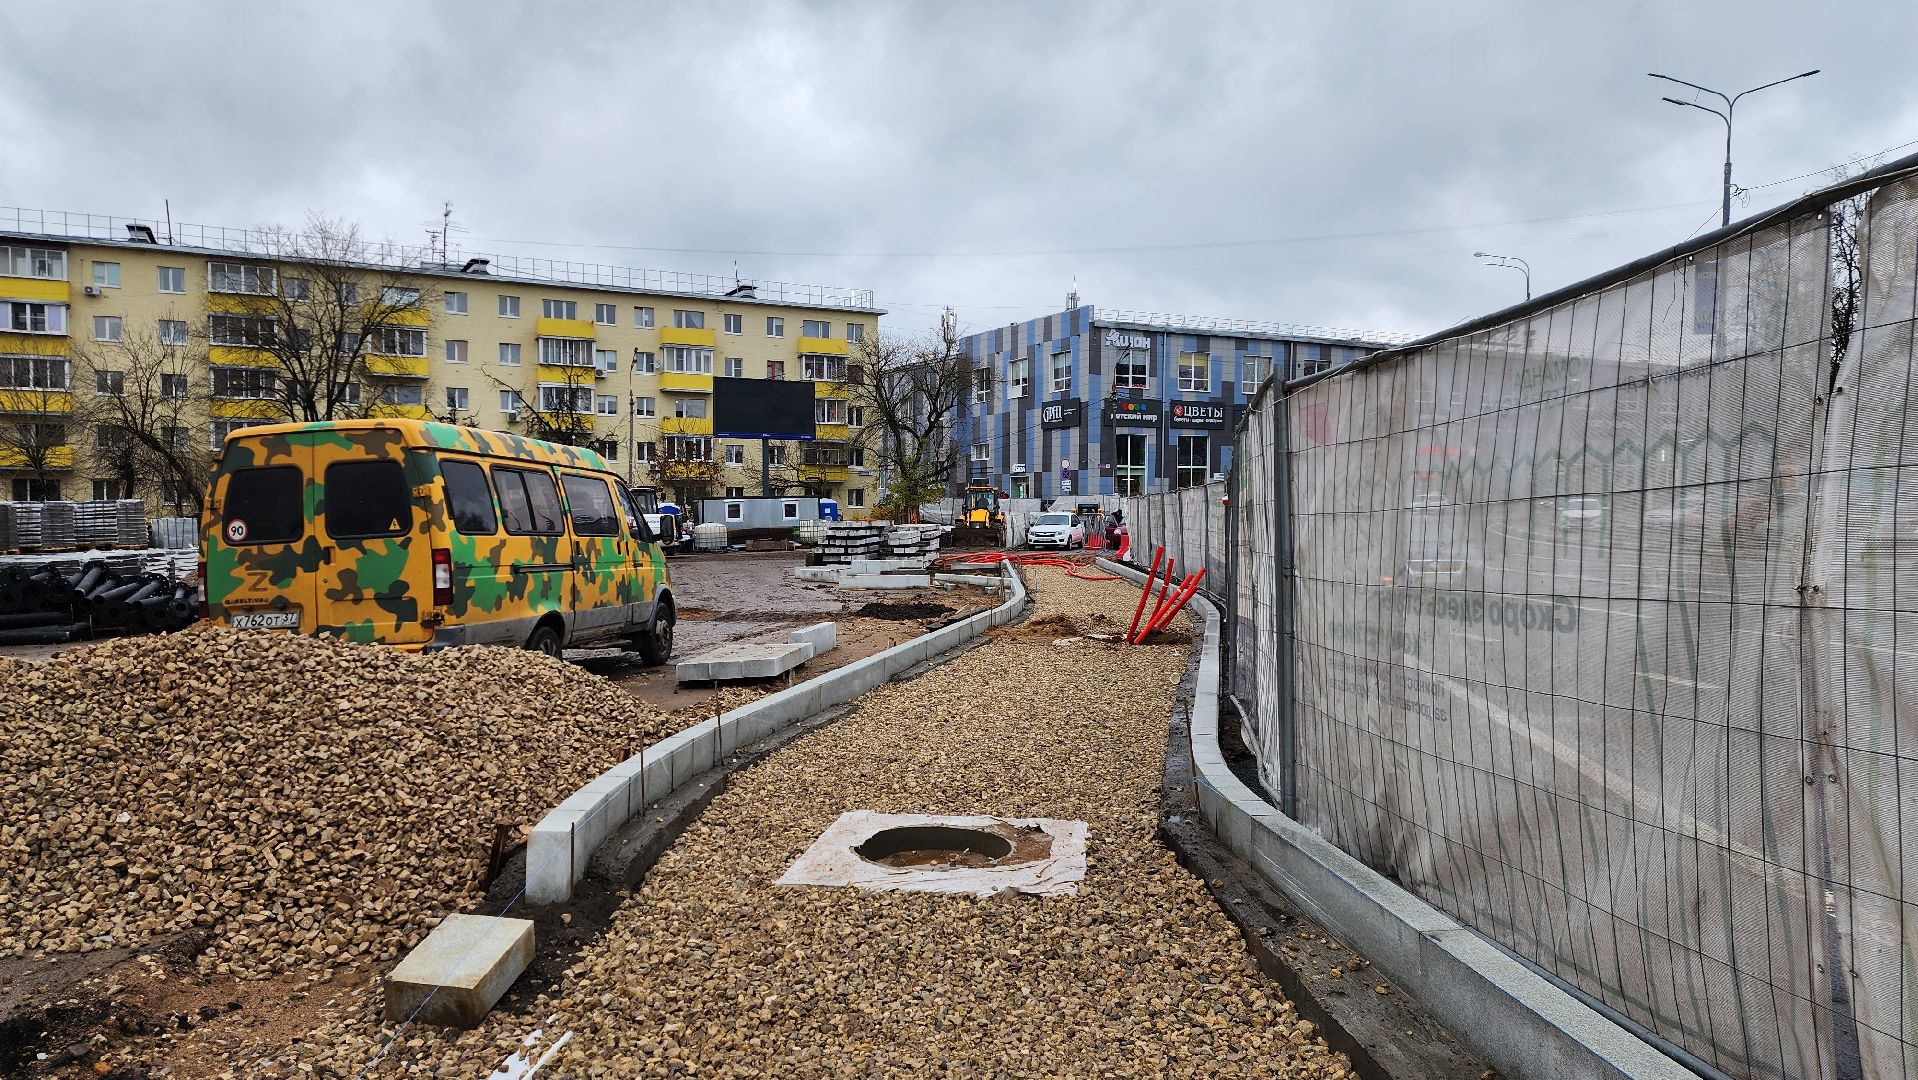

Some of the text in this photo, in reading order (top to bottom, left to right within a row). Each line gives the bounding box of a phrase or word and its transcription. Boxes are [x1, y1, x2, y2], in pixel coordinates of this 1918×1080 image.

[1184, 405, 1223, 418] ЦВЕТЫ
[231, 526, 243, 536] 90
[246, 571, 268, 592] Z
[281, 612, 294, 622] 37
